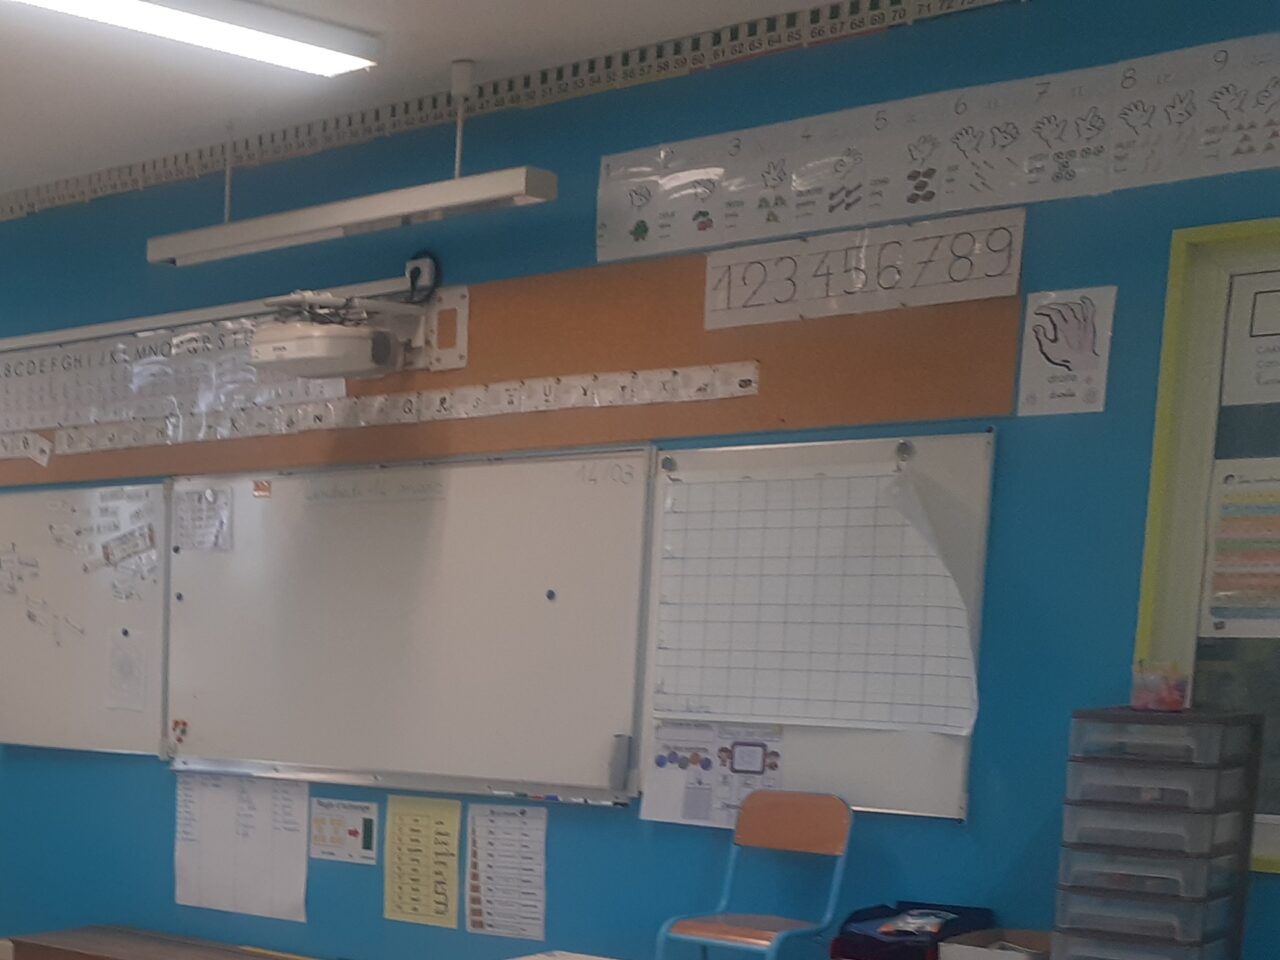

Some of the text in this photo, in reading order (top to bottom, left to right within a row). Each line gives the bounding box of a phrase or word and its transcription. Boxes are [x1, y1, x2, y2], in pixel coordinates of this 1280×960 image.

[873, 109, 889, 131] 5
[953, 97, 968, 116] 6
[1035, 81, 1052, 98] 7
[1120, 67, 1137, 89] 8
[1213, 49, 1229, 69] 9
